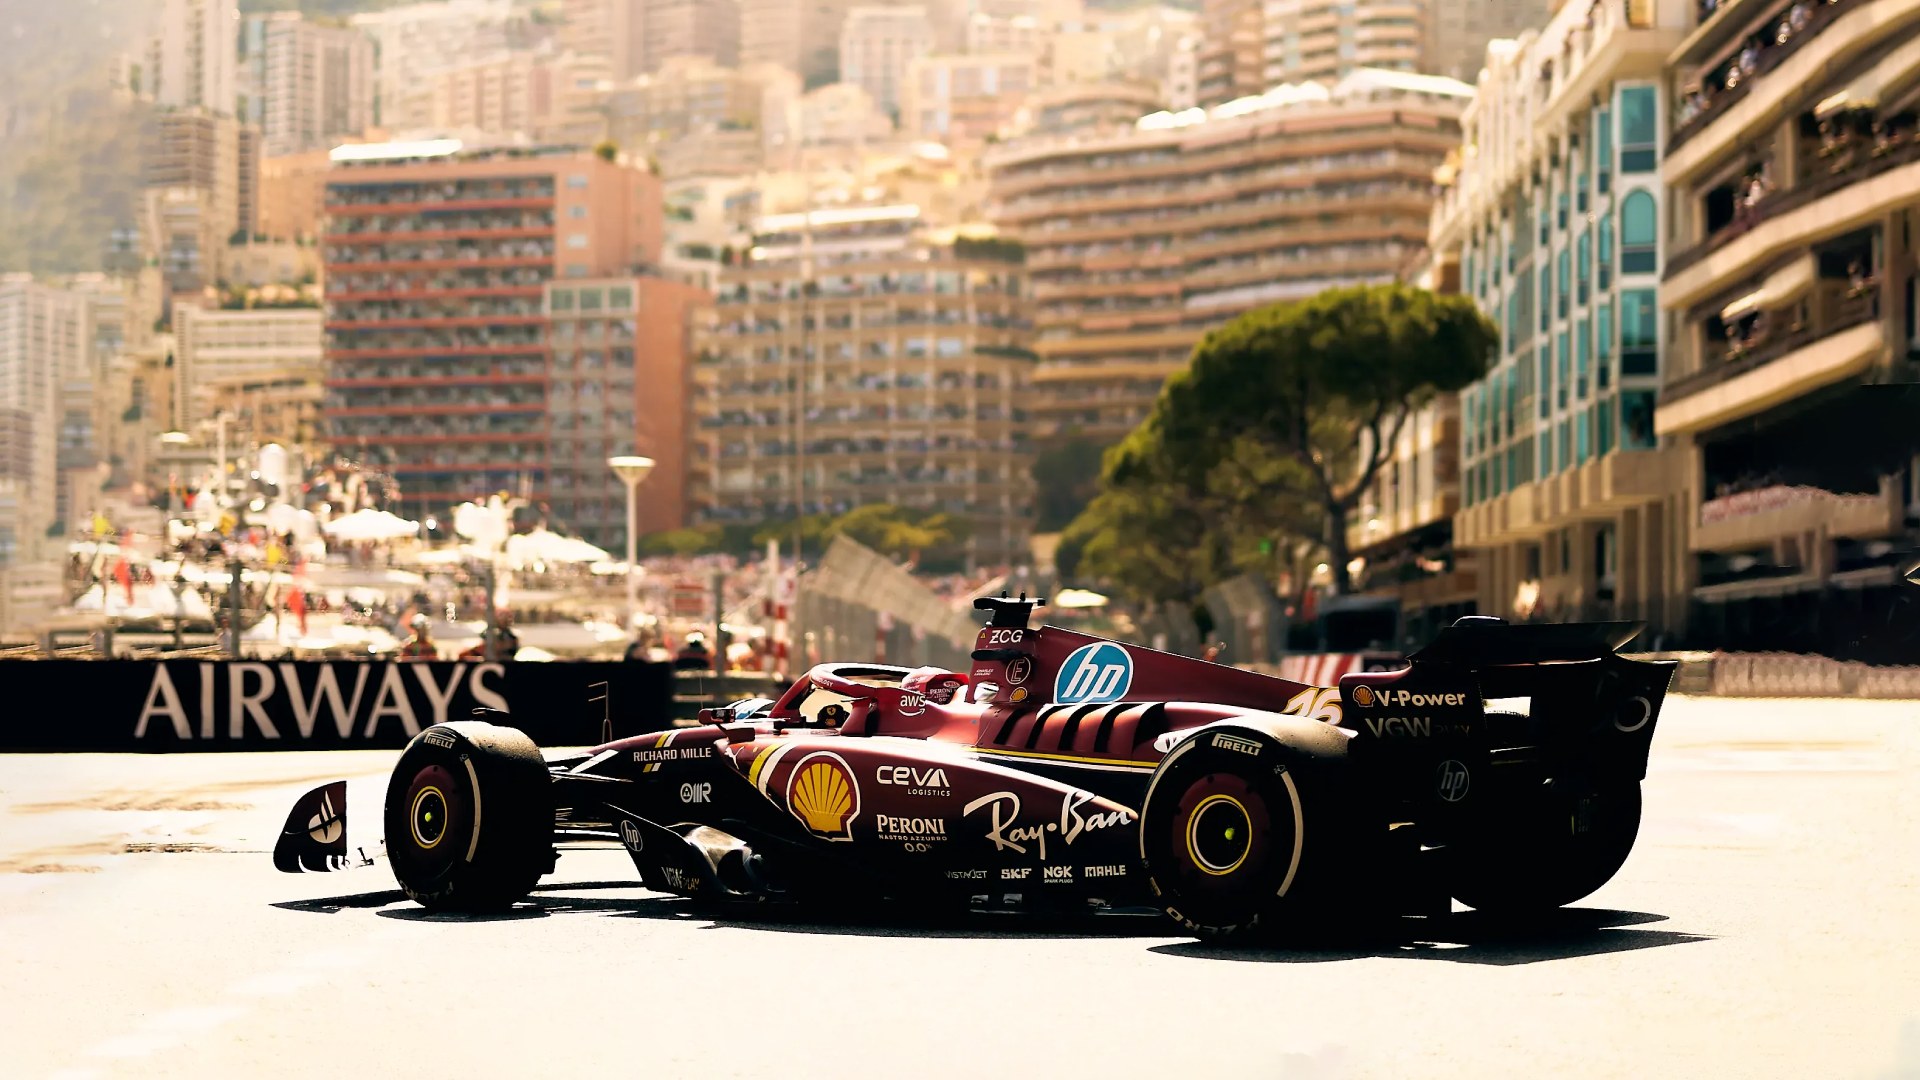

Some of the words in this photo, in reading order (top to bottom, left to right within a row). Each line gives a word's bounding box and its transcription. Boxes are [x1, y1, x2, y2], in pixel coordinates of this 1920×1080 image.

[989, 629, 1024, 644] ZCG
[1061, 642, 1126, 704] hp
[134, 662, 509, 740] AIRWAYS
[900, 694, 926, 708] aws
[1281, 686, 1344, 727] 16
[1375, 689, 1467, 708] V-Power
[1365, 716, 1431, 739] VGW
[423, 732, 456, 749] PIRELLI
[1211, 732, 1263, 756] PIRELLI
[633, 749, 678, 762] RICHARD
[680, 747, 712, 759] MILLE
[1439, 760, 1466, 801] hp
[907, 788, 951, 797] LOGISTICS
[876, 814, 946, 834] PERONI
[1001, 868, 1032, 879] SKF
[1043, 865, 1073, 879] NGK
[1084, 864, 1127, 878] MAHLE
